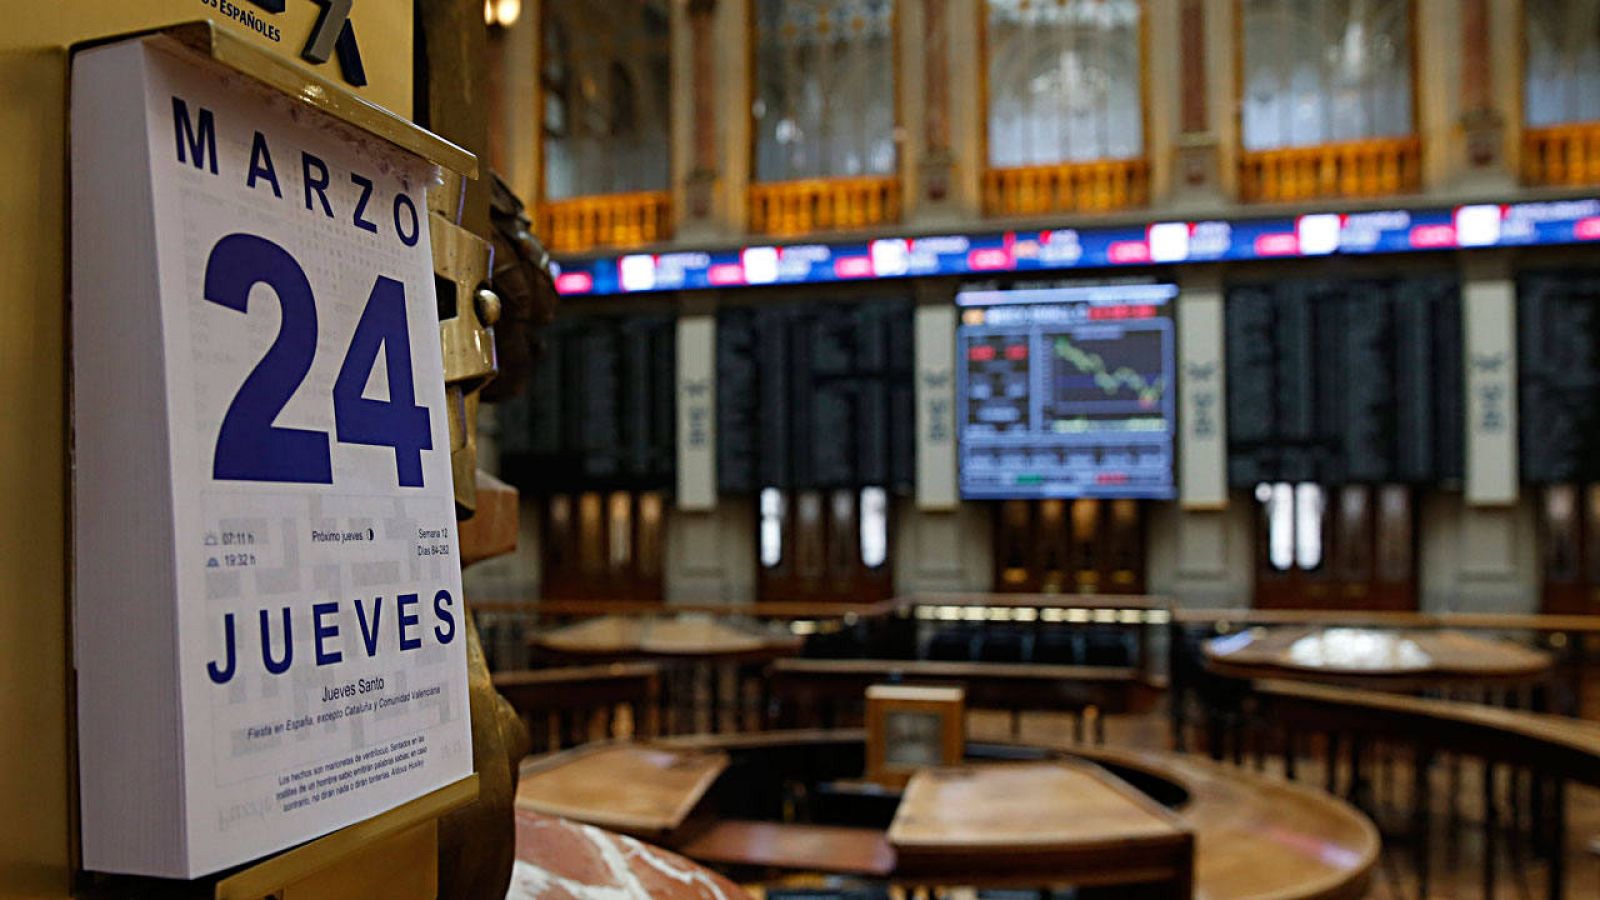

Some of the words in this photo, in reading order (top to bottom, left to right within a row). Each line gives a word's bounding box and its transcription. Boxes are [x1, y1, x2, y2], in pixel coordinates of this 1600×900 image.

[219, 0, 281, 42] ESPAÑOLES
[172, 96, 419, 247] MARZO
[204, 233, 433, 487] 24
[341, 531, 363, 544] jueves
[418, 528, 440, 539] Semana
[207, 589, 455, 684] JUEVES
[322, 683, 356, 702] Jueves
[358, 676, 384, 694] Santo
[248, 725, 272, 740] Fiesta
[317, 710, 343, 724] excepto
[379, 693, 411, 709] Comunidad
